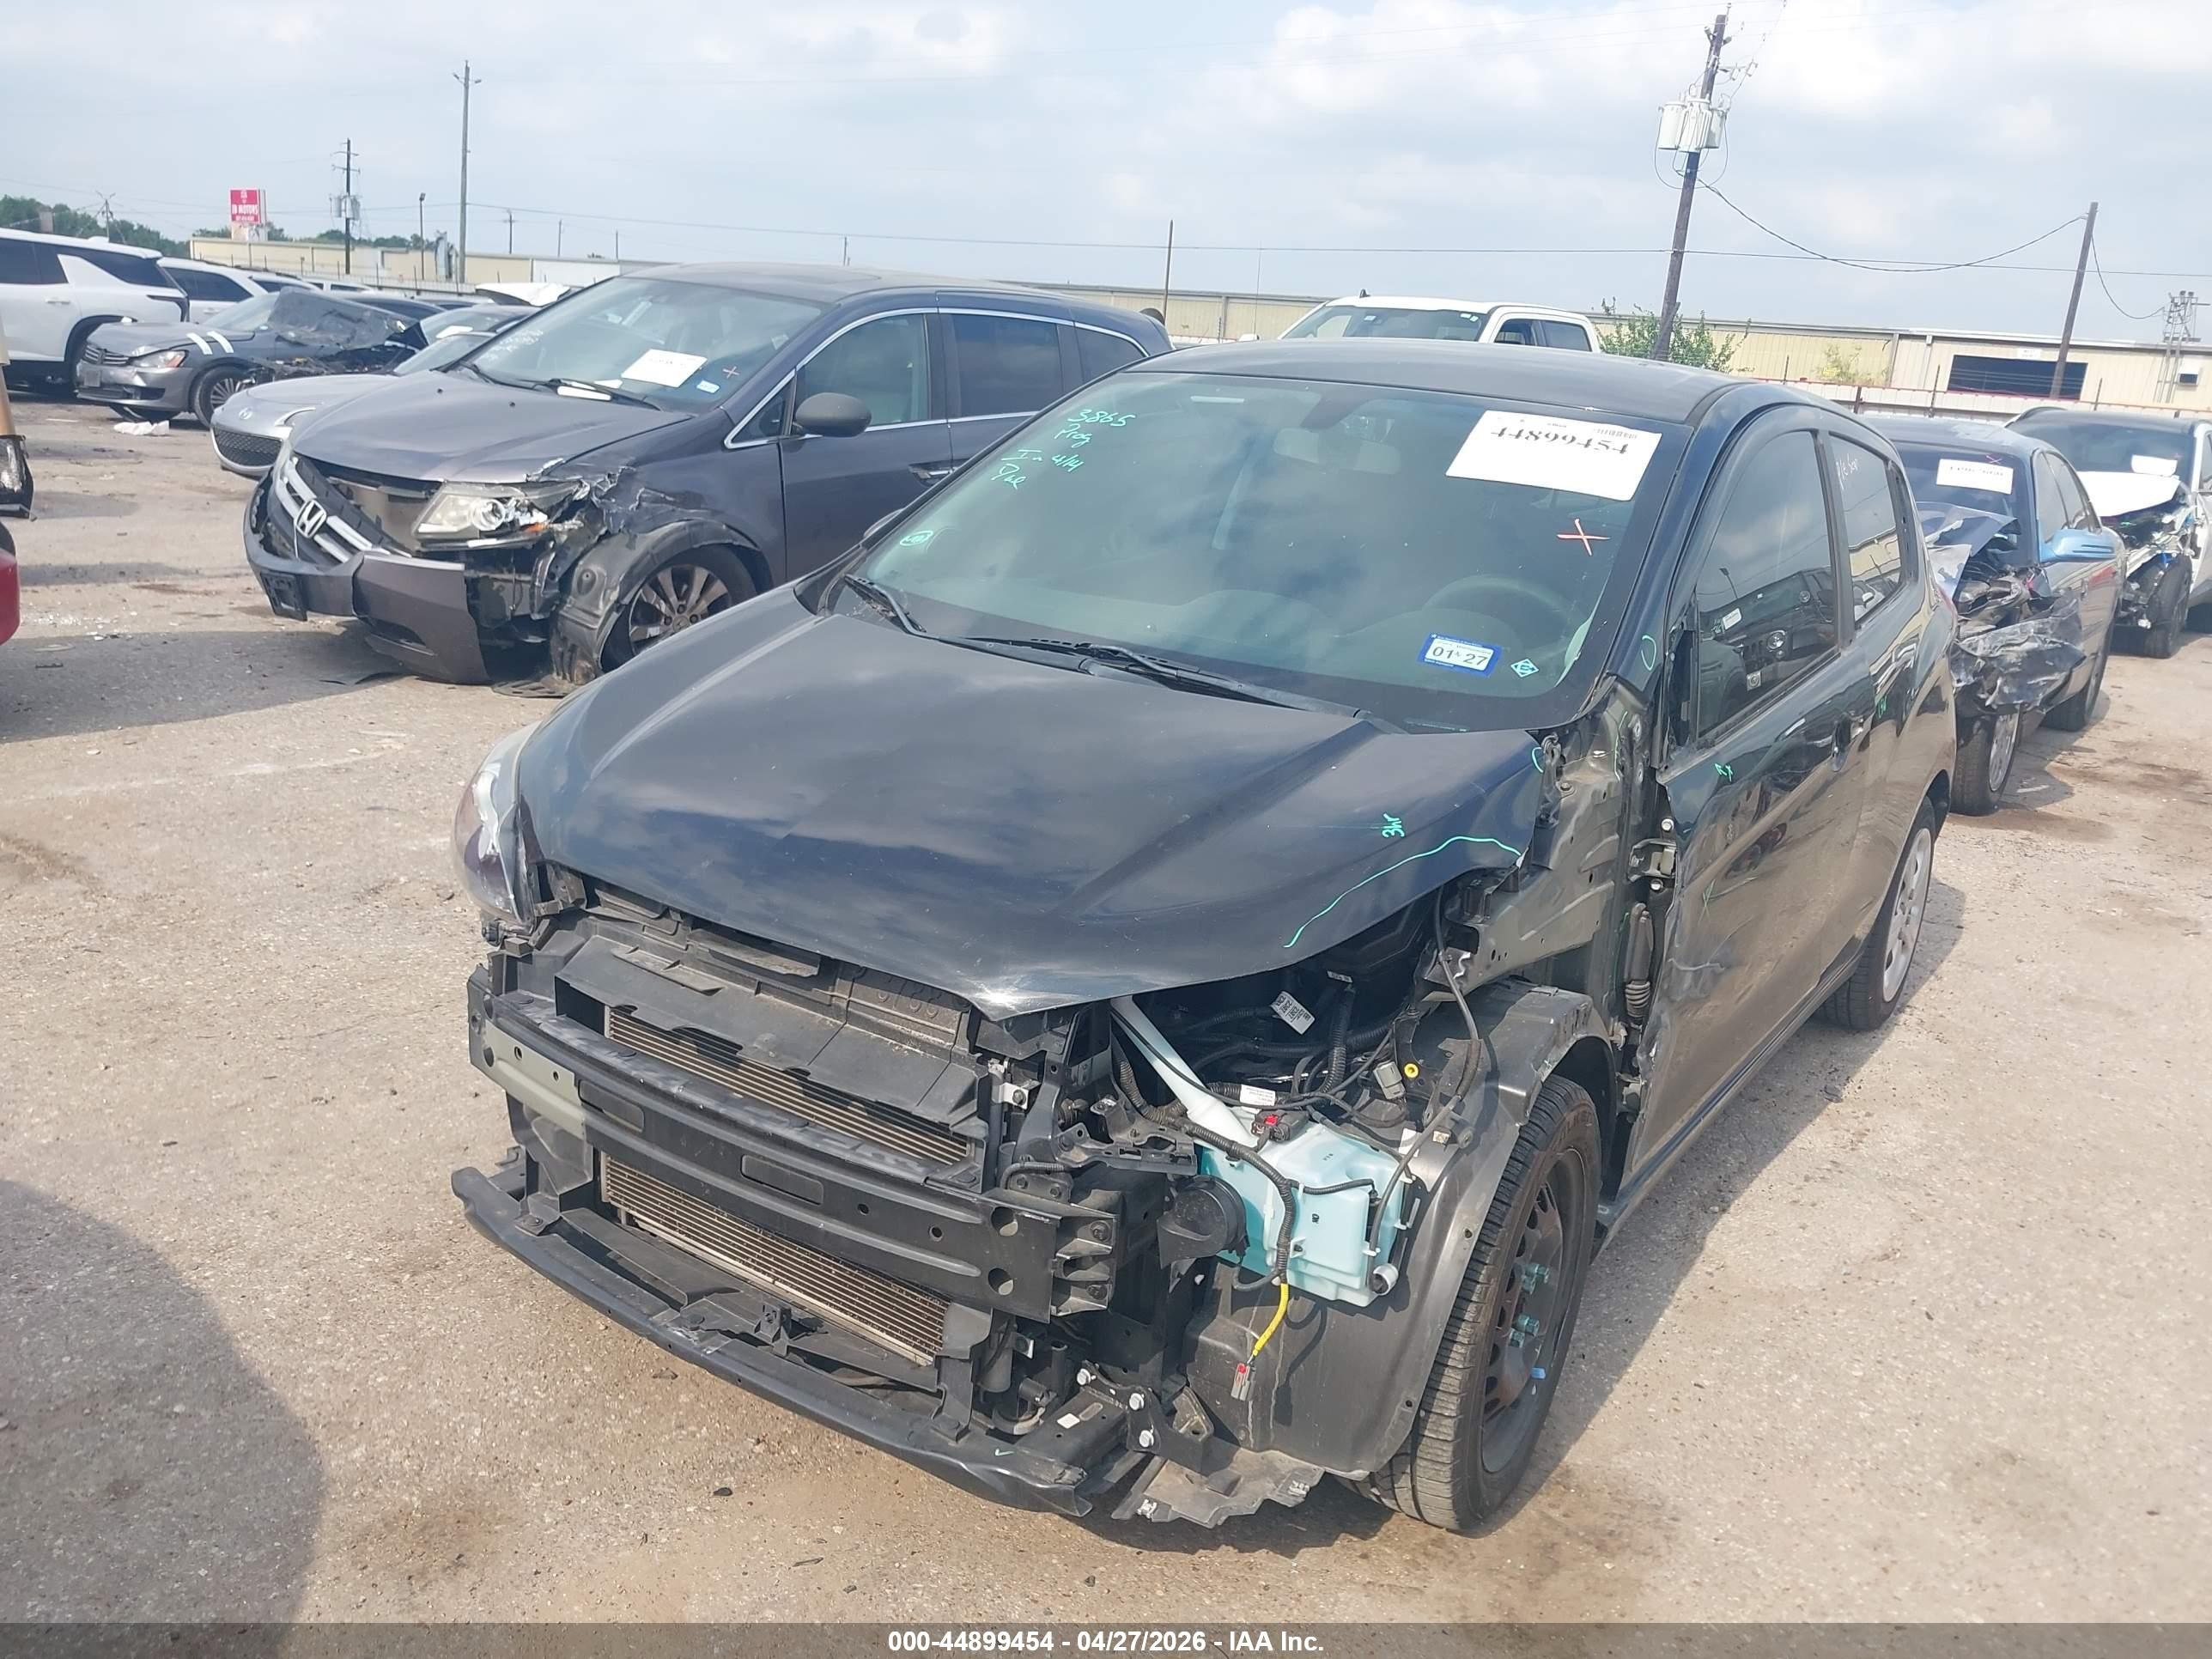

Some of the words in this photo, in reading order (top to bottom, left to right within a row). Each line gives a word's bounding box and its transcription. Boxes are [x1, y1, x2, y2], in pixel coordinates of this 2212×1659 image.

[1067, 409, 1136, 427] 3865
[1490, 426, 1629, 454] 44899454
[1432, 647, 1455, 659] 01
[1462, 653, 1488, 666] 27
